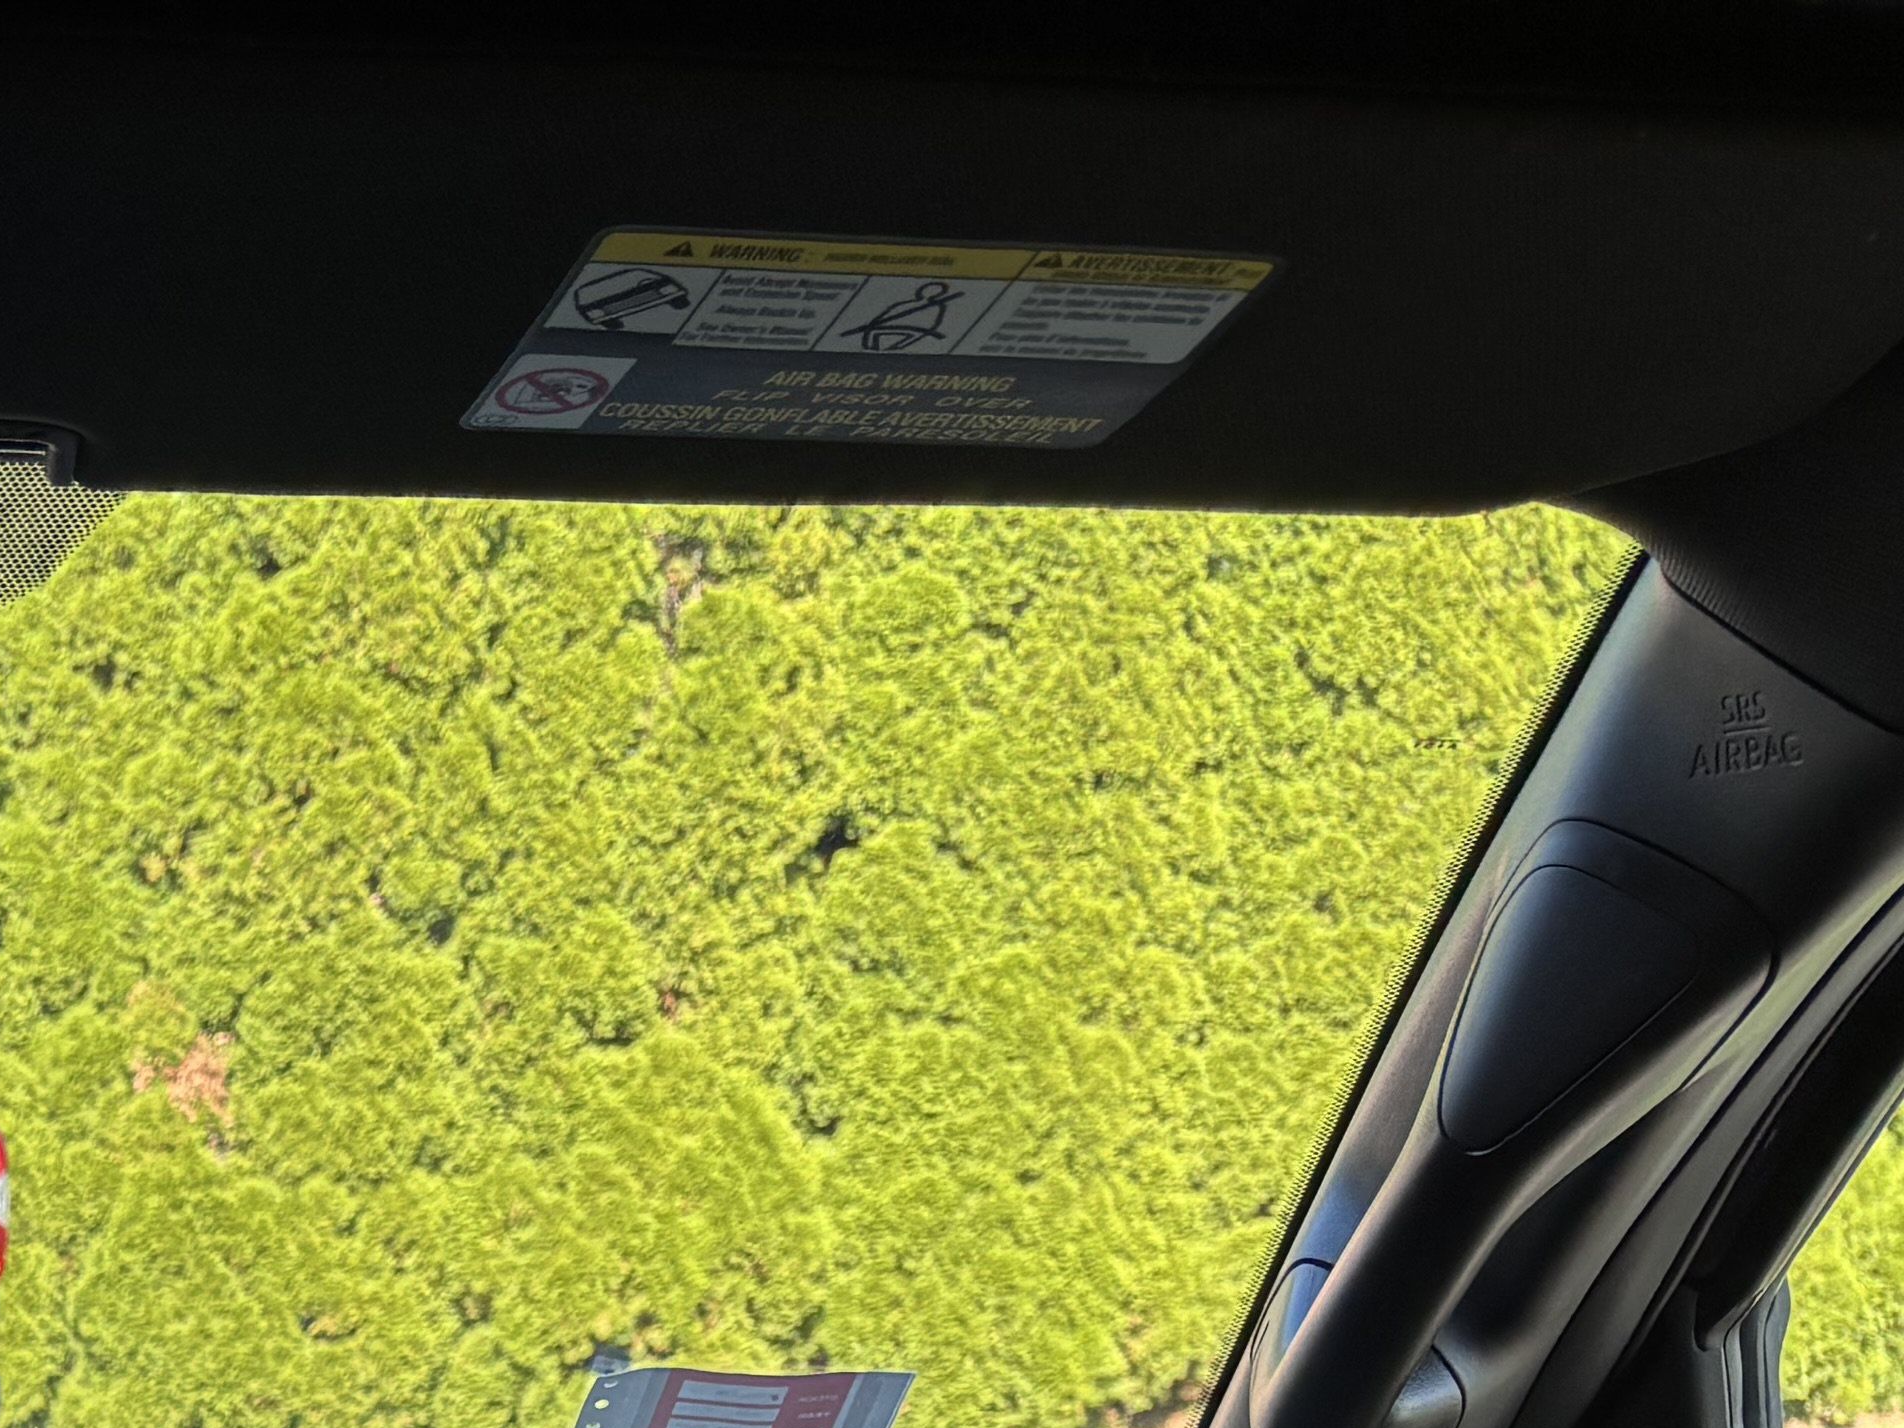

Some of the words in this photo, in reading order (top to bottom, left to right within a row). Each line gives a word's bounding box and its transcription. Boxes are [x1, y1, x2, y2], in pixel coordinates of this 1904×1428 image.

[762, 370, 817, 387] AIR
[815, 372, 879, 389] BAG
[880, 373, 1018, 393] WARNING
[710, 389, 791, 401] FLIP
[810, 391, 916, 406] VISOR
[934, 395, 1034, 410] OVER
[598, 402, 722, 420] COUSSIN
[721, 405, 883, 427] GONFLABLE
[878, 410, 1107, 434] AVERTISSEMENT
[616, 419, 769, 435] REPLIER
[783, 424, 831, 437] LE
[848, 425, 1056, 445] PARESOLEIL
[1720, 690, 1768, 726] SRS
[1688, 732, 1806, 780] AIRBAG
